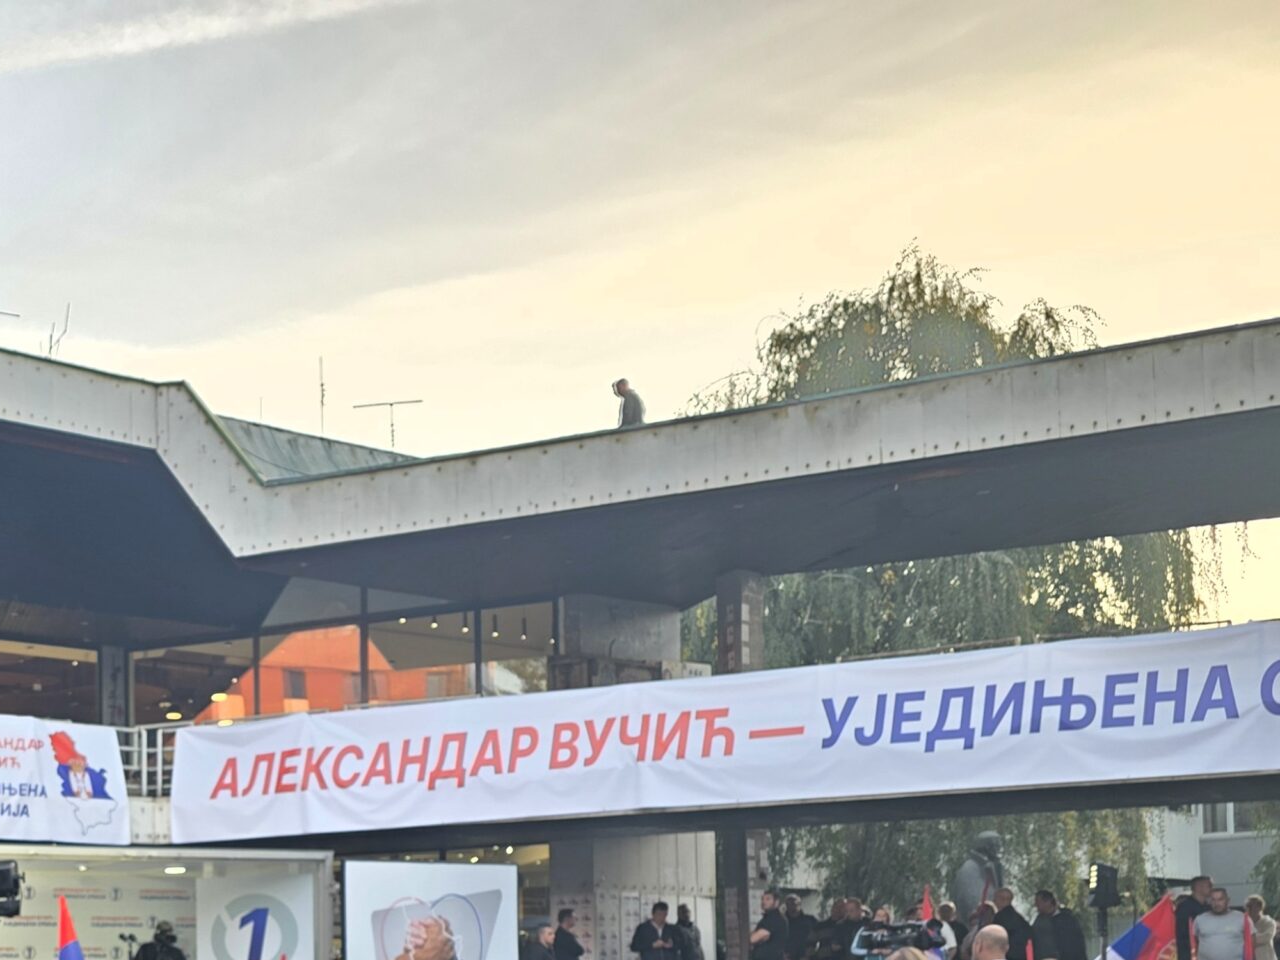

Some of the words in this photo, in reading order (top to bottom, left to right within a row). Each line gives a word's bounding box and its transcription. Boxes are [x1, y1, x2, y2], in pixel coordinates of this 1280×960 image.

[210, 726, 539, 800] АЛЕКСАНДАР
[548, 708, 736, 770] ВУЧИЋ
[820, 664, 1240, 753] УЈЕДИЊЕНА
